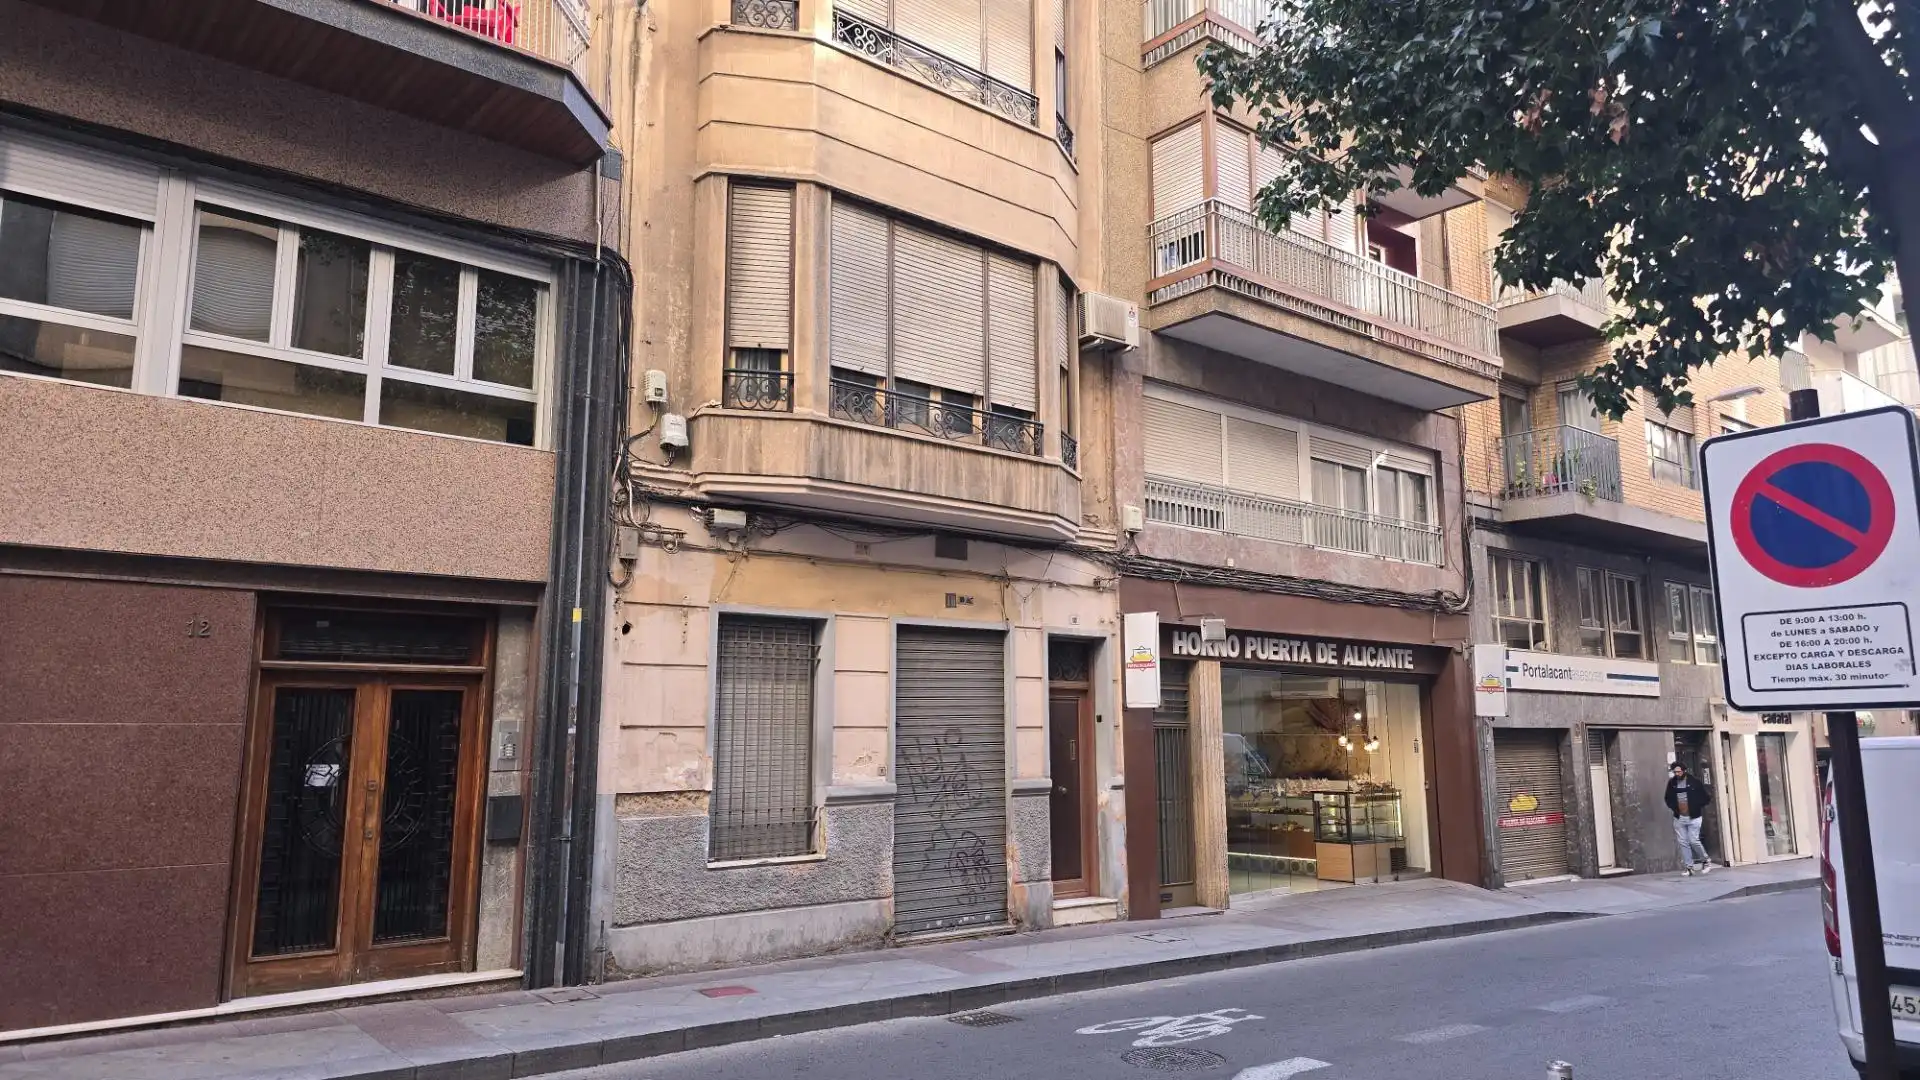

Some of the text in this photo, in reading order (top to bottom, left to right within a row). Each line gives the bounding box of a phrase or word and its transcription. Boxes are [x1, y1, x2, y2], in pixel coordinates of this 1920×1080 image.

[1795, 616, 1815, 624] 9:00
[1828, 613, 1855, 622] 13:00
[185, 617, 211, 638] 12
[1785, 628, 1817, 636] LUNES
[1829, 624, 1870, 634] SABADO
[1795, 639, 1821, 647] 16:00
[1834, 636, 1861, 645] 20:00
[1172, 629, 1414, 670] HORNO PUERTA DE ALICANTE
[1754, 652, 1798, 661] EXCEPTO
[1800, 650, 1835, 659] CARGA
[1848, 646, 1905, 656] DESCARGA
[1521, 662, 1573, 681] Portalacant
[1811, 660, 1872, 670] LABORALES
[1835, 673, 1847, 681] 30
[1850, 672, 1889, 681] minuto
[1891, 994, 1920, 1015] 45
